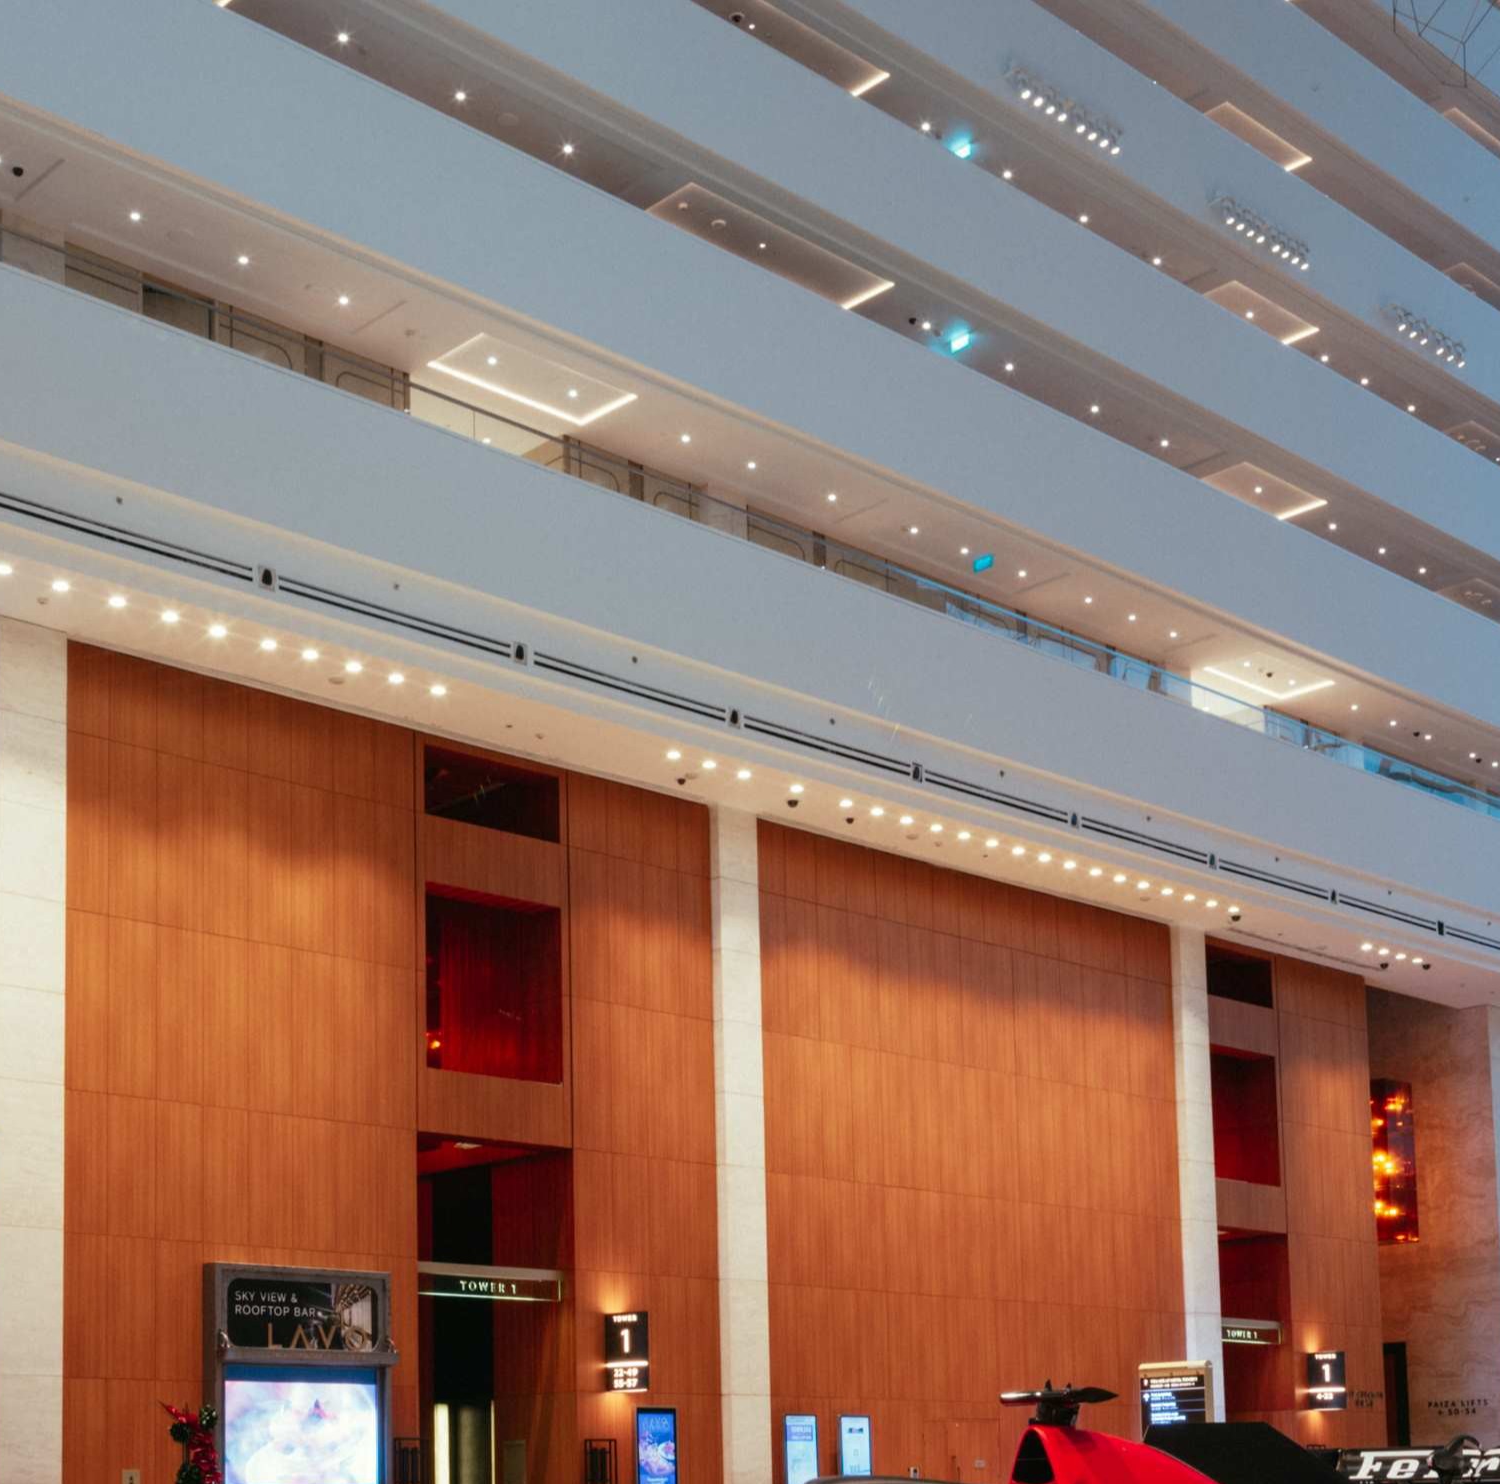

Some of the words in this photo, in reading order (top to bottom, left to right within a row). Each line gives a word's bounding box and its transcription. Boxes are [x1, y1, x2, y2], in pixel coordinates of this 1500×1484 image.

[460, 1280, 505, 1294] TOWER
[511, 1284, 517, 1294] 1
[235, 1290, 255, 1301] SKY
[260, 1292, 286, 1302] VIEW
[290, 1293, 298, 1303] &
[235, 1305, 290, 1317] ROOFTOP
[294, 1307, 316, 1318] BAR
[613, 1314, 637, 1322] TOWER
[620, 1328, 631, 1354] 1
[1321, 1363, 1331, 1382] 1
